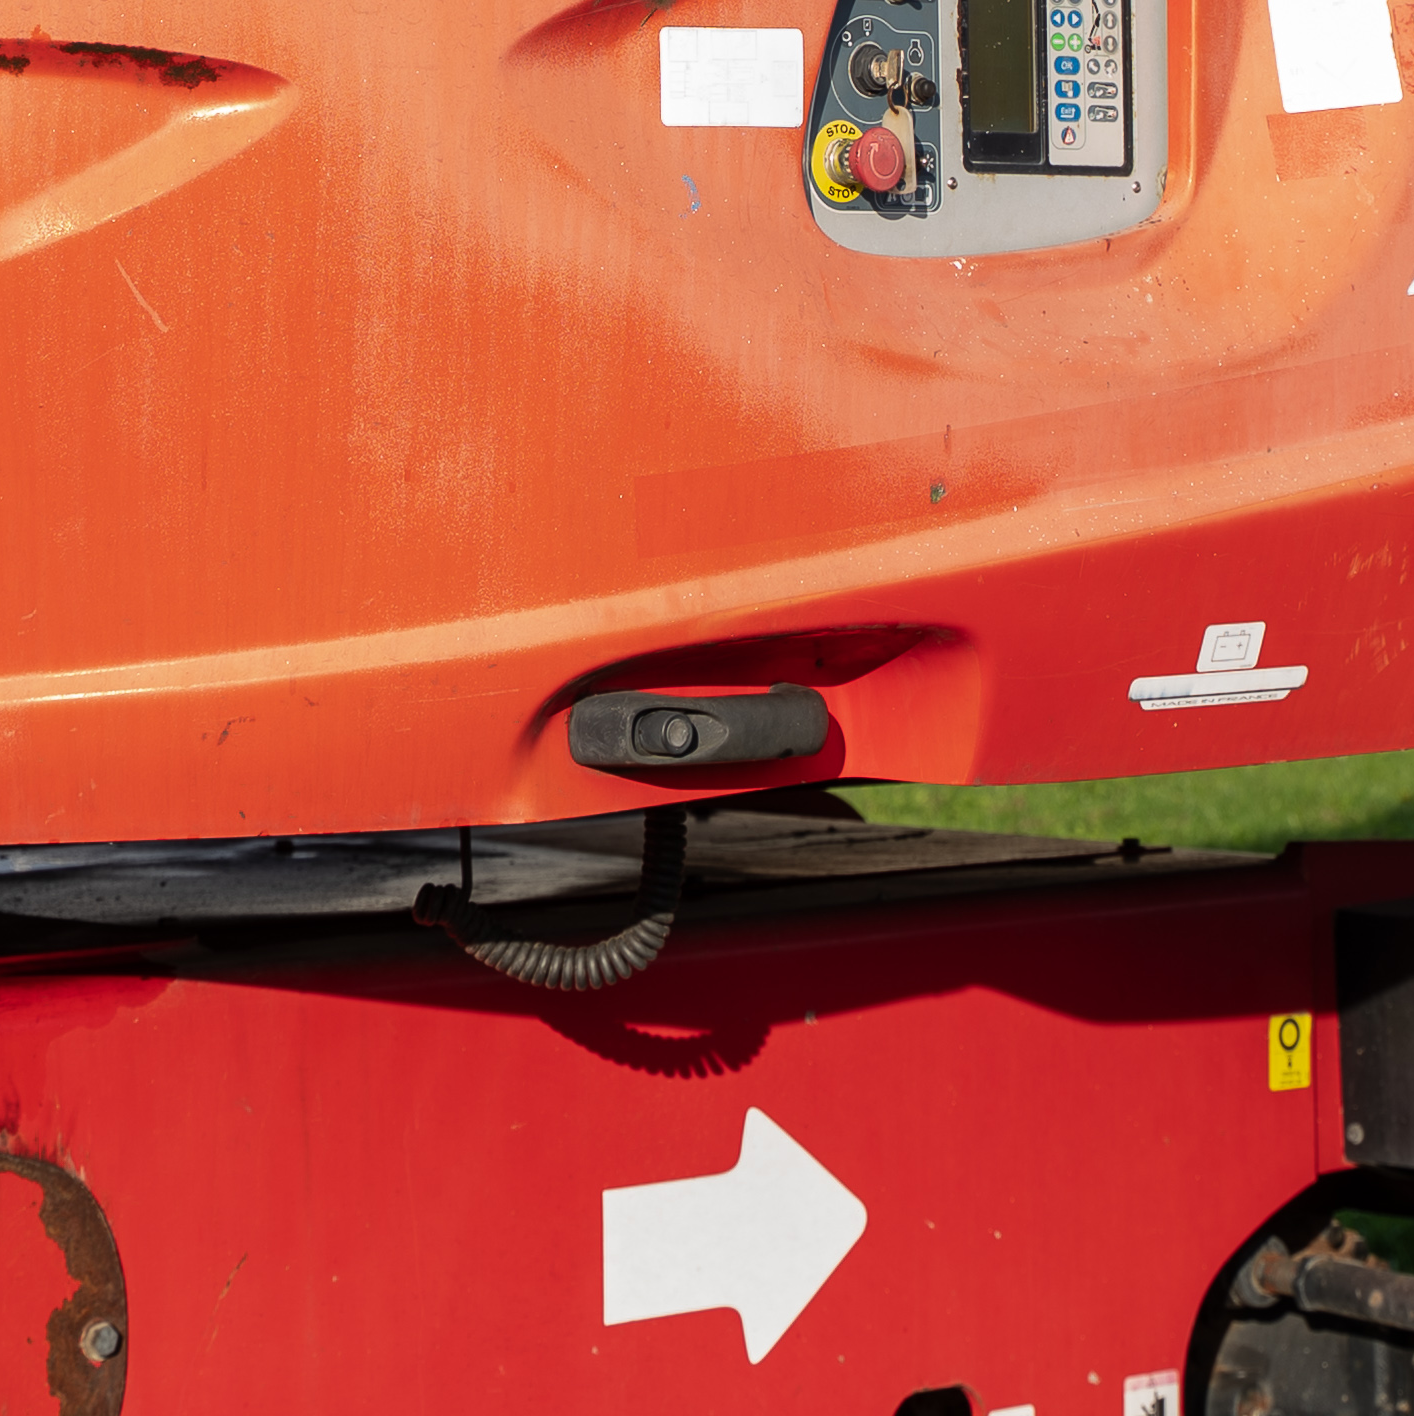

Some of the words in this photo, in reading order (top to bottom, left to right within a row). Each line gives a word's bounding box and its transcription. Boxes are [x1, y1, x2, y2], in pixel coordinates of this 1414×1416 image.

[1060, 60, 1074, 71] OK
[826, 123, 856, 138] STOP
[828, 185, 857, 199] STOP
[1150, 699, 1198, 708] MADE
[1201, 697, 1215, 705] IN
[1217, 693, 1279, 704] FRANCE
